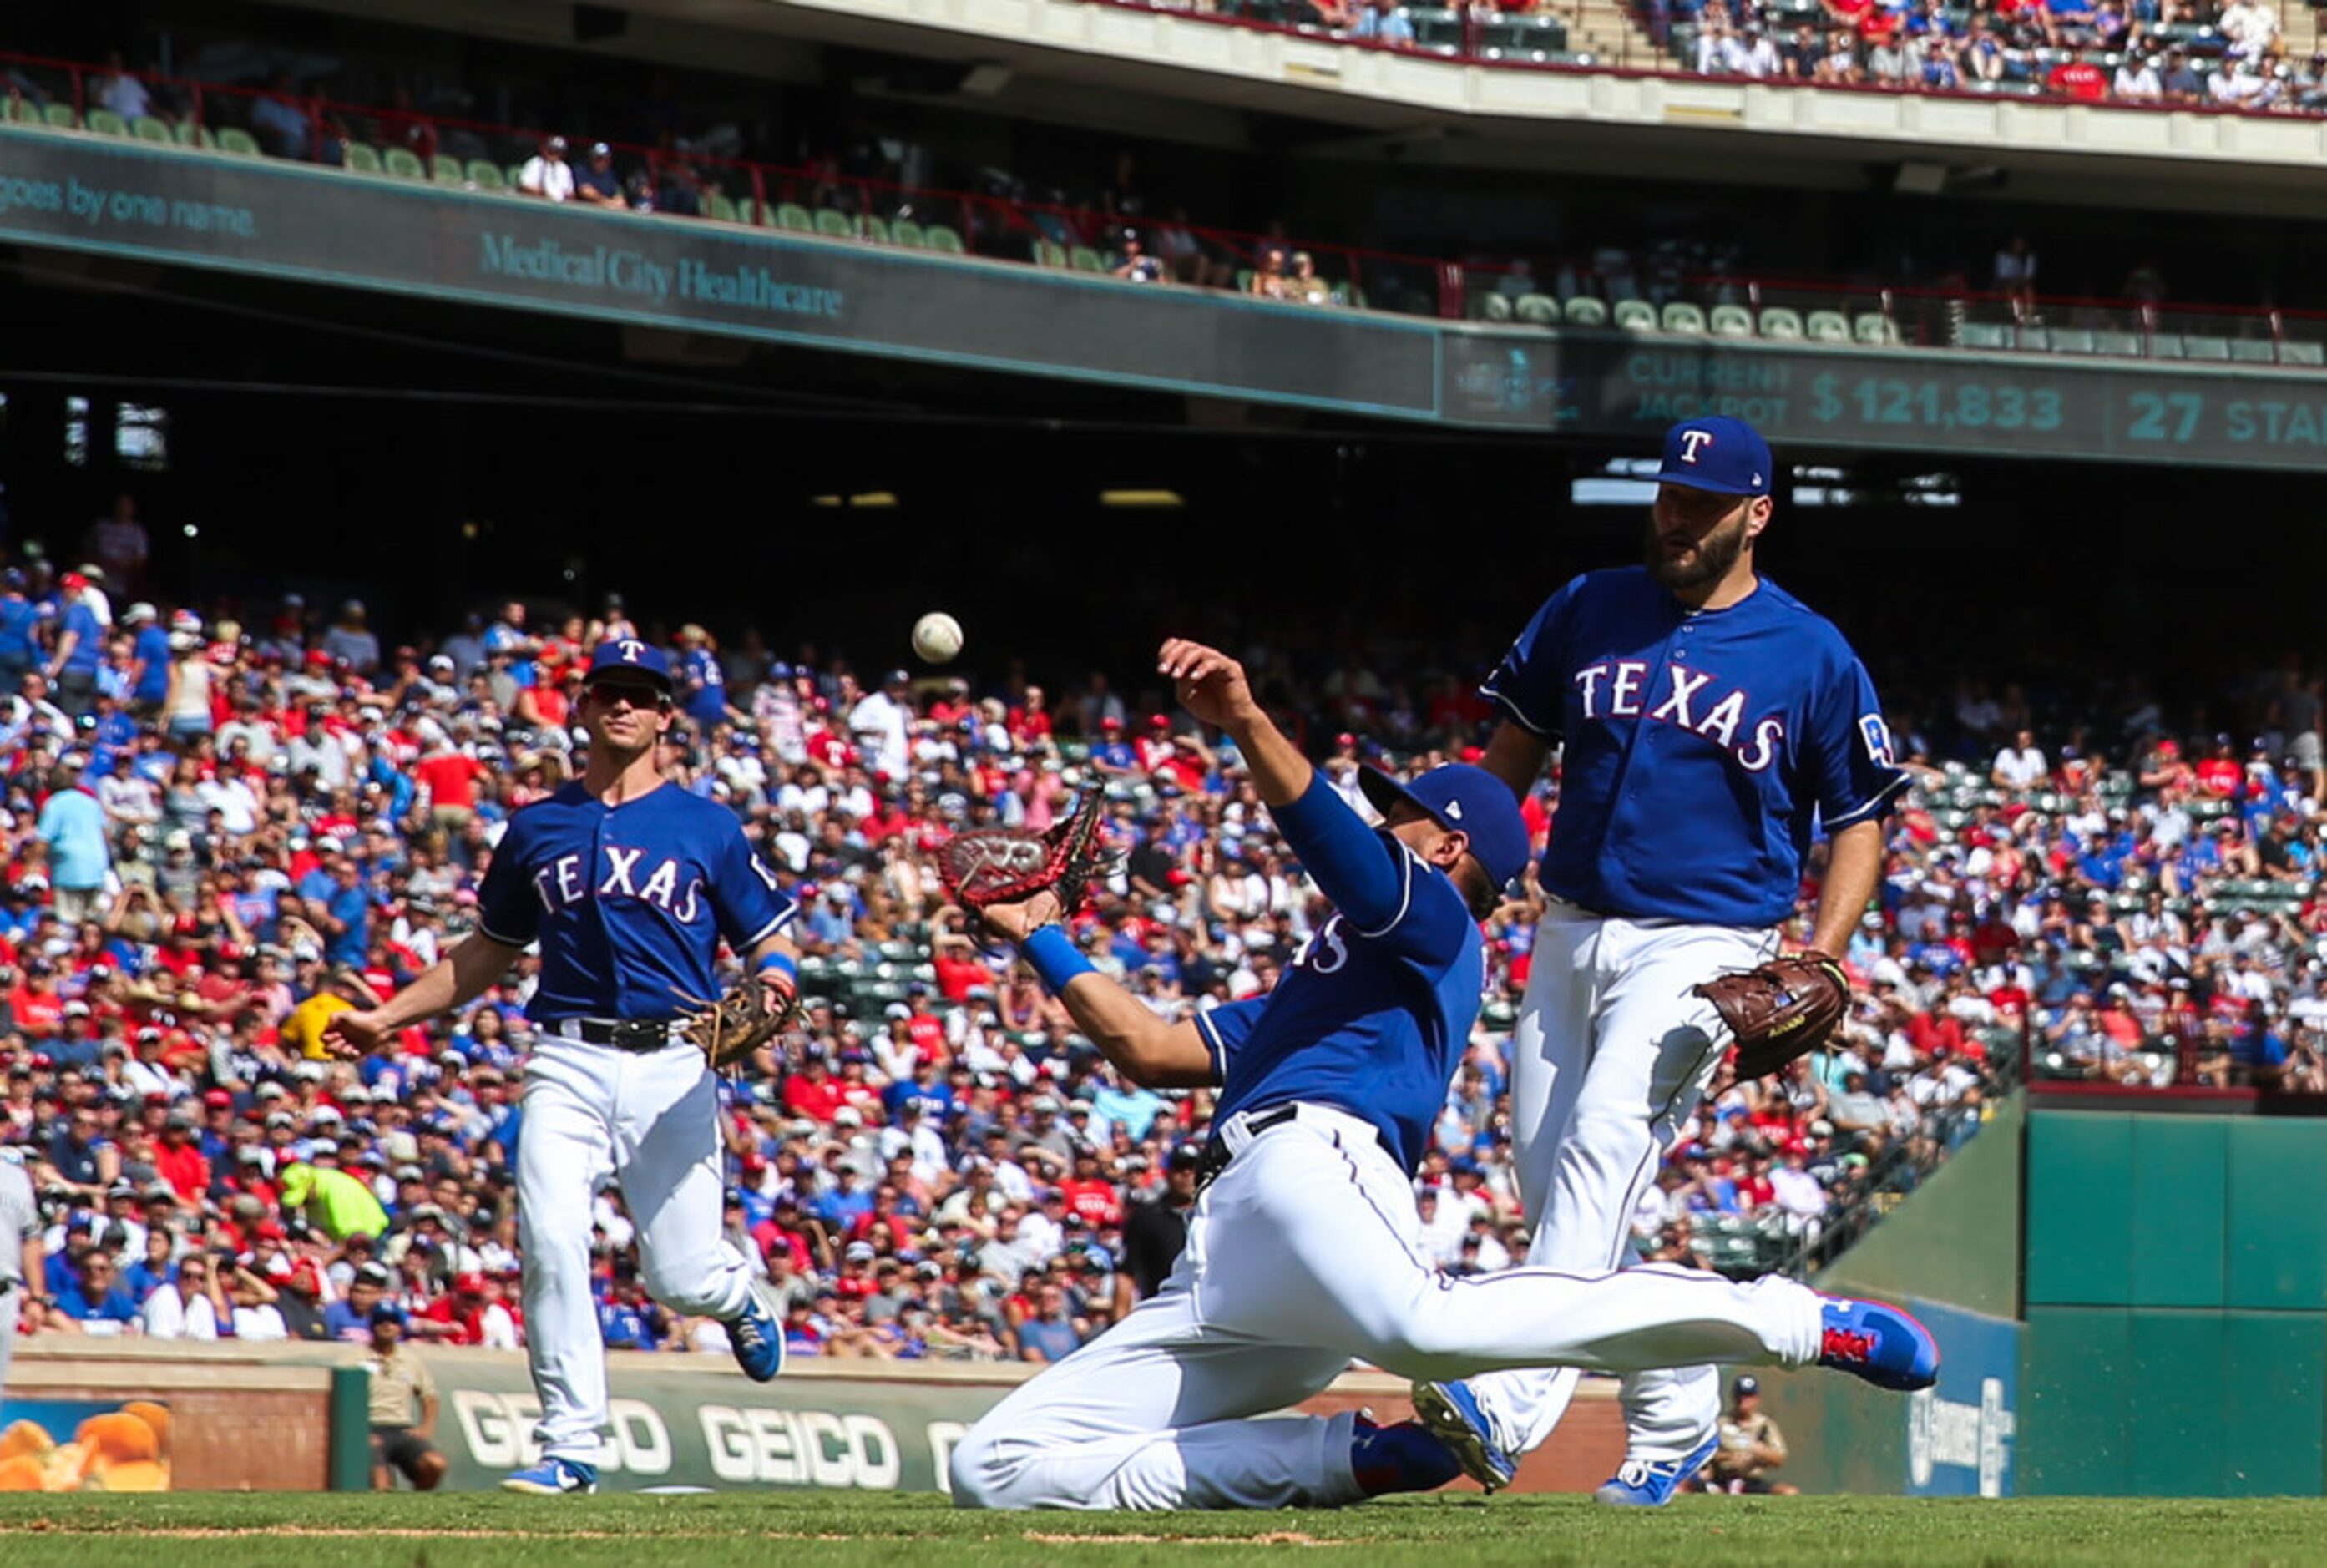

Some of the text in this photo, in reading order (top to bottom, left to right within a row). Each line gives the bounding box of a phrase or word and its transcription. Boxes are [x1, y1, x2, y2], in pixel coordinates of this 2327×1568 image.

[67, 174, 107, 225] by
[110, 191, 167, 226] one
[481, 233, 844, 317] Medical City Healthcare
[1629, 356, 1792, 391] CURRENT
[1854, 376, 2063, 432] 121,833
[2127, 392, 2327, 445] 27 STA
[1681, 430, 1712, 463] T
[618, 640, 646, 662] T
[1575, 662, 1784, 771] TEXAS
[531, 845, 705, 924] TEXAS
[698, 1404, 900, 1490] GEICO
